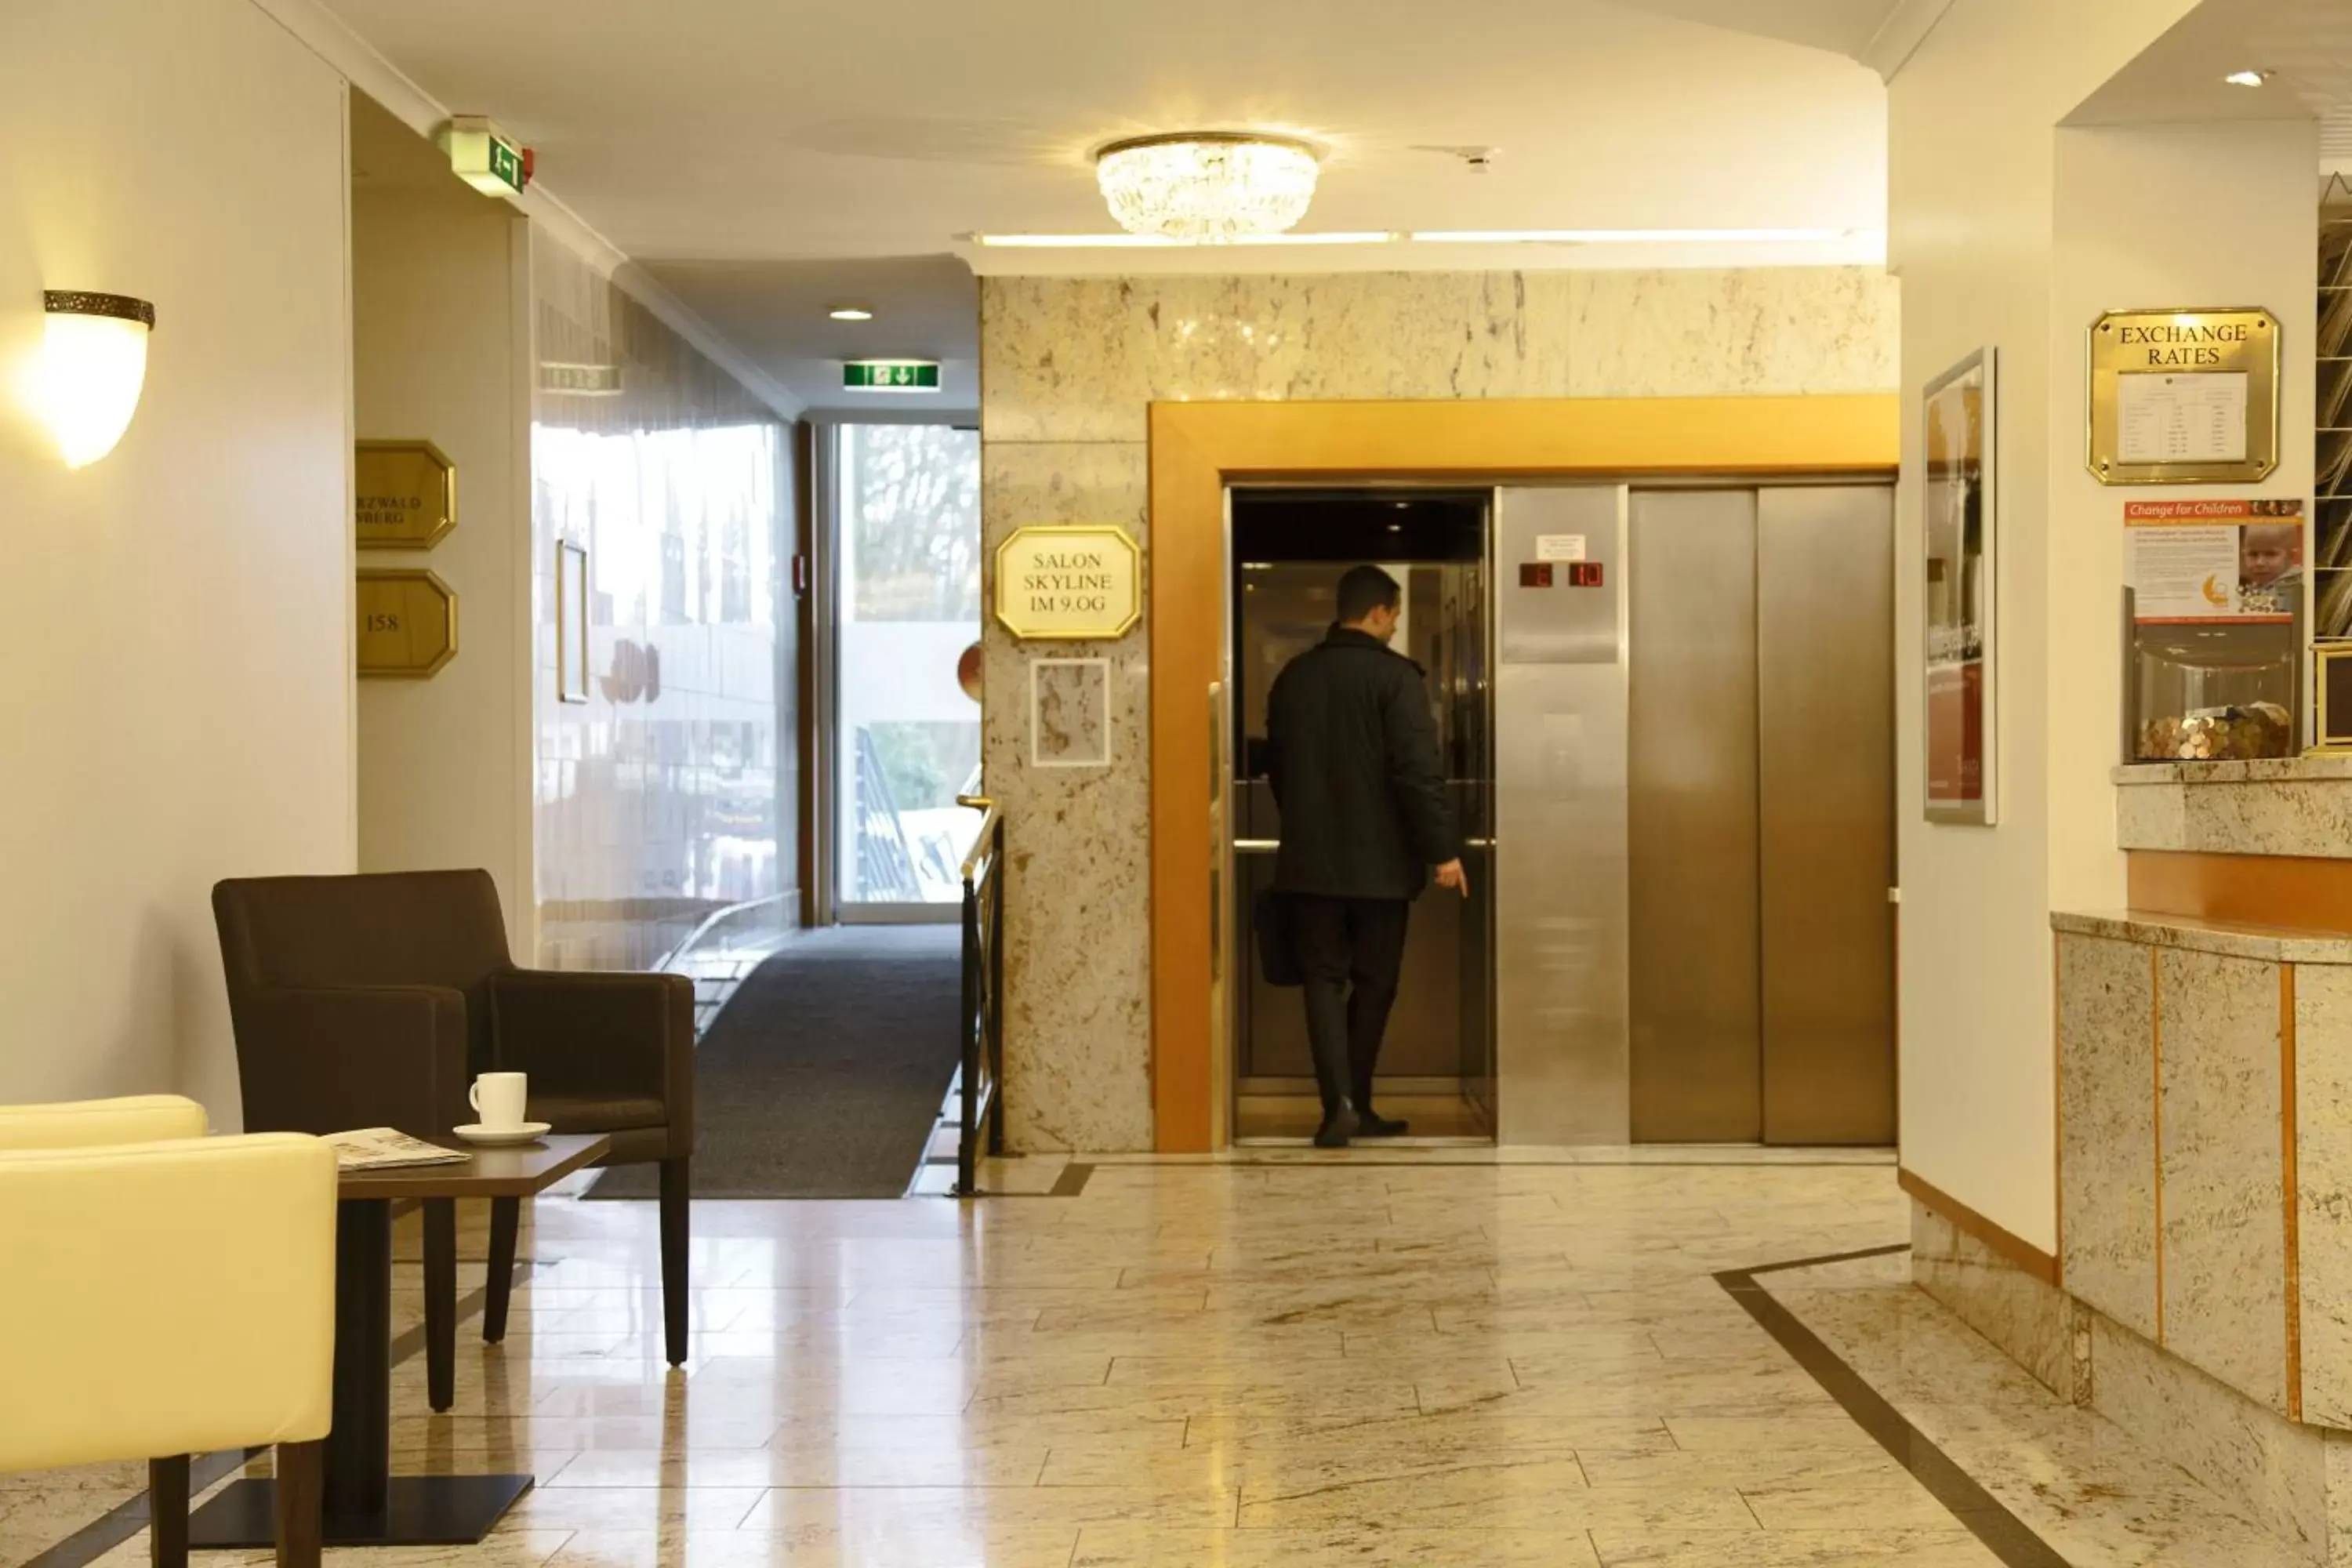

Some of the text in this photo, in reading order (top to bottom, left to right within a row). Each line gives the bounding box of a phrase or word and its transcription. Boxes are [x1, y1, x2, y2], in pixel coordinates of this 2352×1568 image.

[2120, 324, 2248, 343] EXCHANGE
[2148, 347, 2220, 365] RATES
[2129, 503, 2243, 519] Change for Children
[1033, 552, 1102, 568] SALON
[1023, 573, 1113, 590] SKYLINE
[1030, 595, 1054, 612] IM
[367, 613, 398, 632] 158
